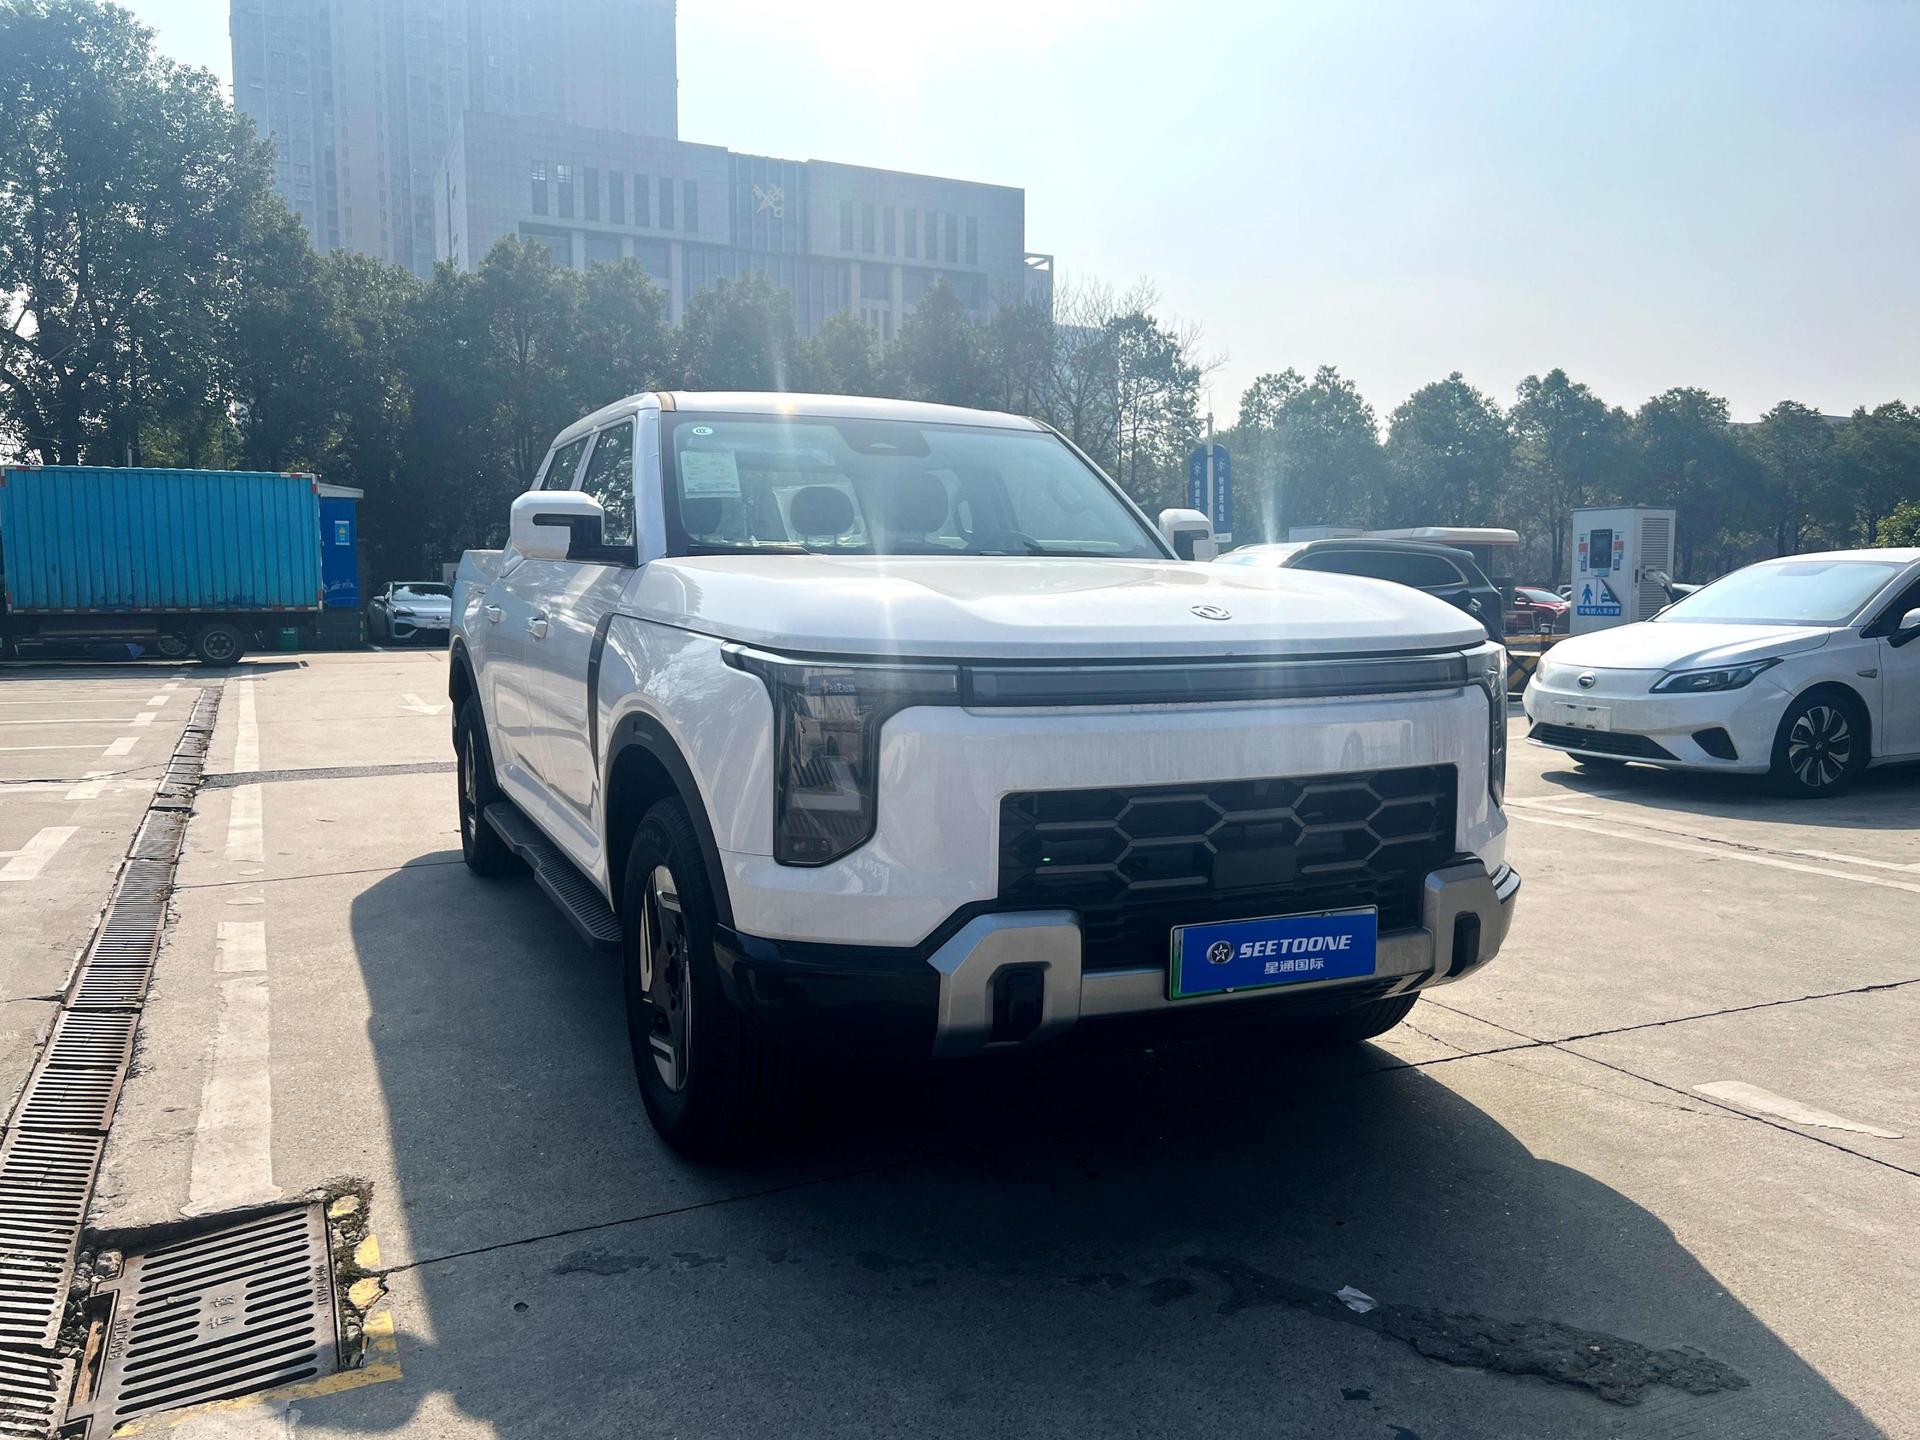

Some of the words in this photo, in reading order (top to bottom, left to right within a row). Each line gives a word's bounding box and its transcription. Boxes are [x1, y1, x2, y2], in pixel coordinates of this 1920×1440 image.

[1239, 935, 1352, 957] SEETOONE
[1264, 958, 1325, 974] 星通国际
